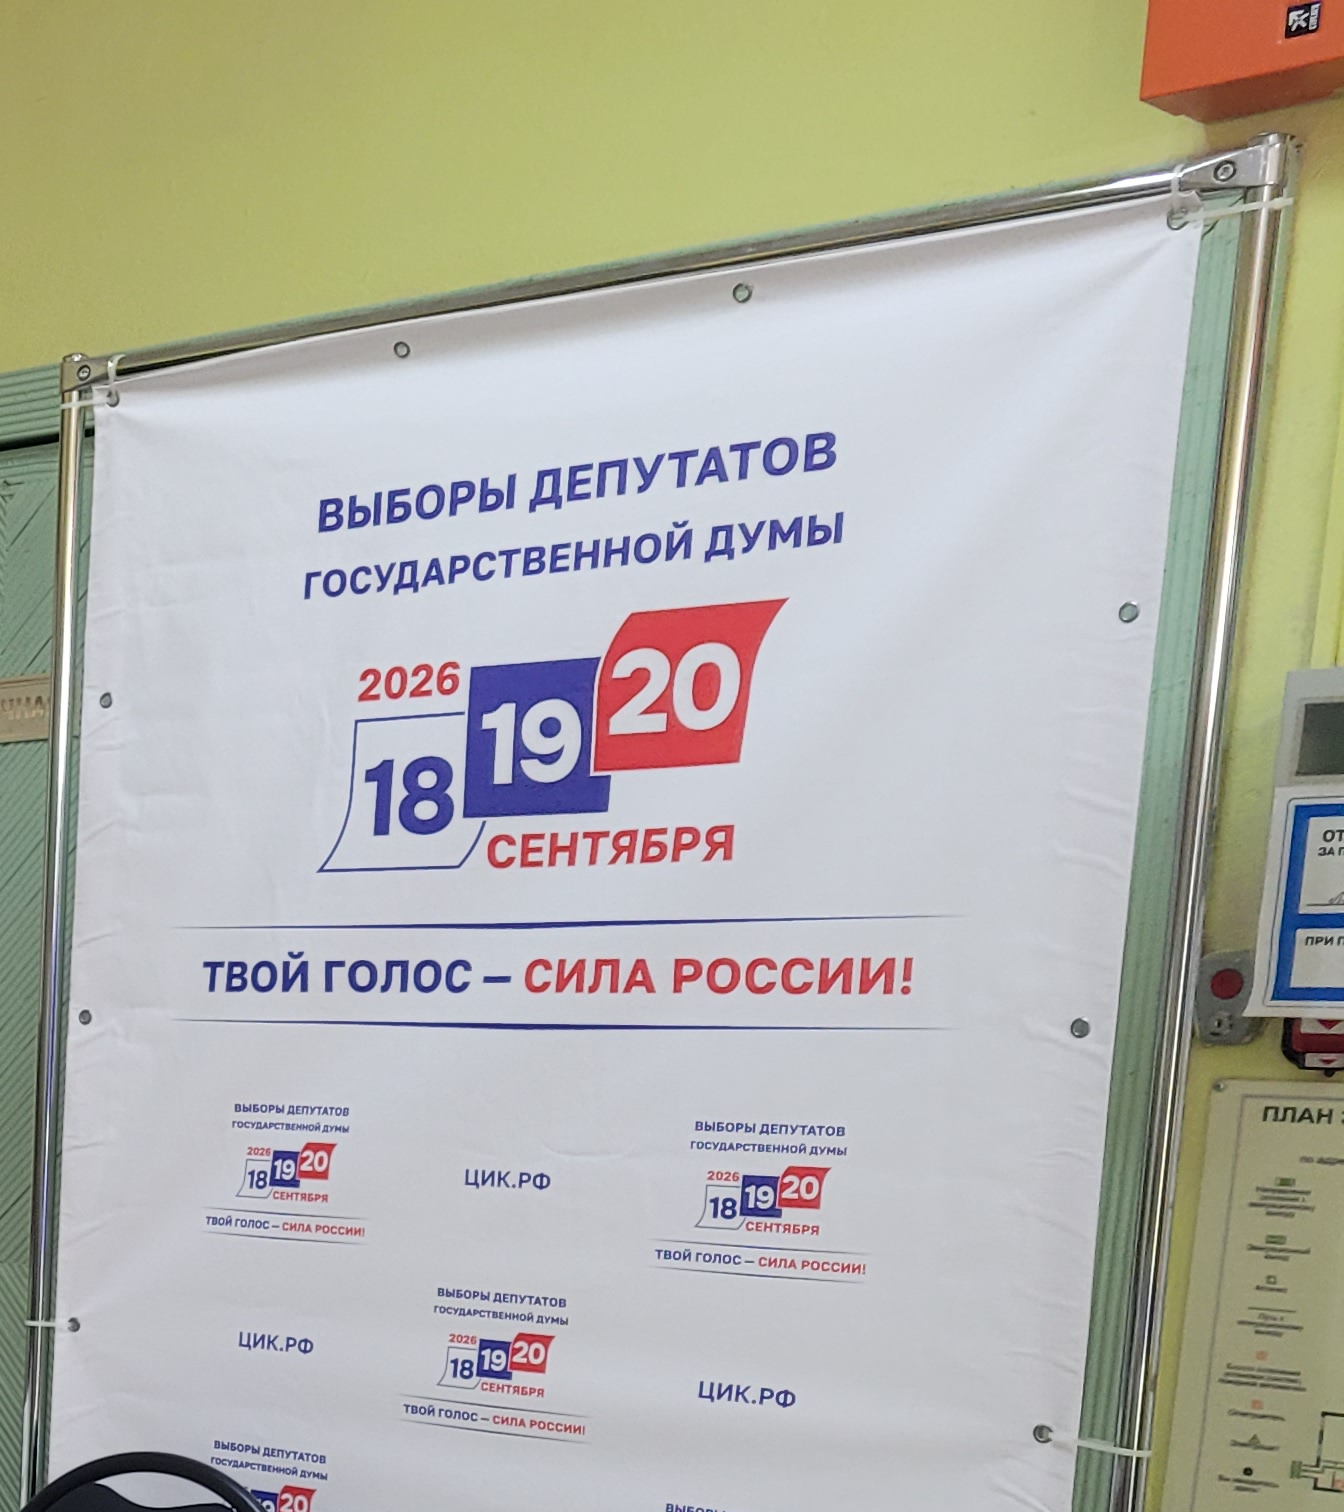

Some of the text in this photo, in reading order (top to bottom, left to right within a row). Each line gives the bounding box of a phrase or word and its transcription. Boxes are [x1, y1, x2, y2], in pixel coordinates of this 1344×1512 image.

[318, 432, 836, 532] ВЫБОРЫ ДЕПУТАТОВ
[304, 512, 844, 600] ГОСУДАРСТВЕННОЙ ДУМЫ
[358, 662, 460, 702] 2026
[364, 643, 740, 836] 18 19 20
[488, 825, 734, 868] СЕНТЯБРЯ
[1318, 846, 1335, 857] ЗА
[1305, 935, 1334, 946] ПРИ
[203, 952, 308, 992] ТВОЙ
[325, 960, 472, 993] ГОЛОС
[524, 958, 656, 994] СИЛА
[673, 958, 913, 995] РОССИИ!
[234, 1103, 350, 1117] ВЫБОРЫ ДЕПУТАТОВ
[1262, 1106, 1334, 1125] ПЛАН
[231, 1120, 350, 1133] ГОСУДАРСТВЕННОЙ ДУМЫ
[694, 1120, 846, 1137] ВЫБОРЫ ДЕПУТАТОВ
[247, 1146, 271, 1157] 2026
[690, 1140, 848, 1156] ГОСУДАРСТВЕННОЙ ДУМЫ
[243, 1149, 329, 1190] 18 19 20
[464, 1168, 551, 1191] ЦИК.РФ
[707, 1170, 740, 1182] 2026
[272, 1190, 329, 1203] СЕНТЯБРЯ
[709, 1175, 820, 1220] 18 19 20
[205, 1215, 366, 1237] ТВОЙ ГОЛОС СИЛА РОССИИ!
[745, 1221, 820, 1236] СЕНТЯБРЯ
[654, 1248, 867, 1275] ТВОЙ ГОЛОС СИЛА РОССИИ!
[437, 1287, 567, 1308] ВЫБОРЫ ДЕПУТАТОВ
[433, 1305, 569, 1326] ГОСУДАРСТВЕННОЙ ДУМЫ
[238, 1331, 314, 1355] ЦИК.РФ
[449, 1333, 477, 1345] 2026
[449, 1341, 546, 1380] 18 19 20
[481, 1381, 545, 1398] СЕНТЯБРЯ
[697, 1380, 797, 1409] ЦИК.РФ
[403, 1403, 587, 1436] ТВОЙ ГОЛОС СИЛА РОССИИ!
